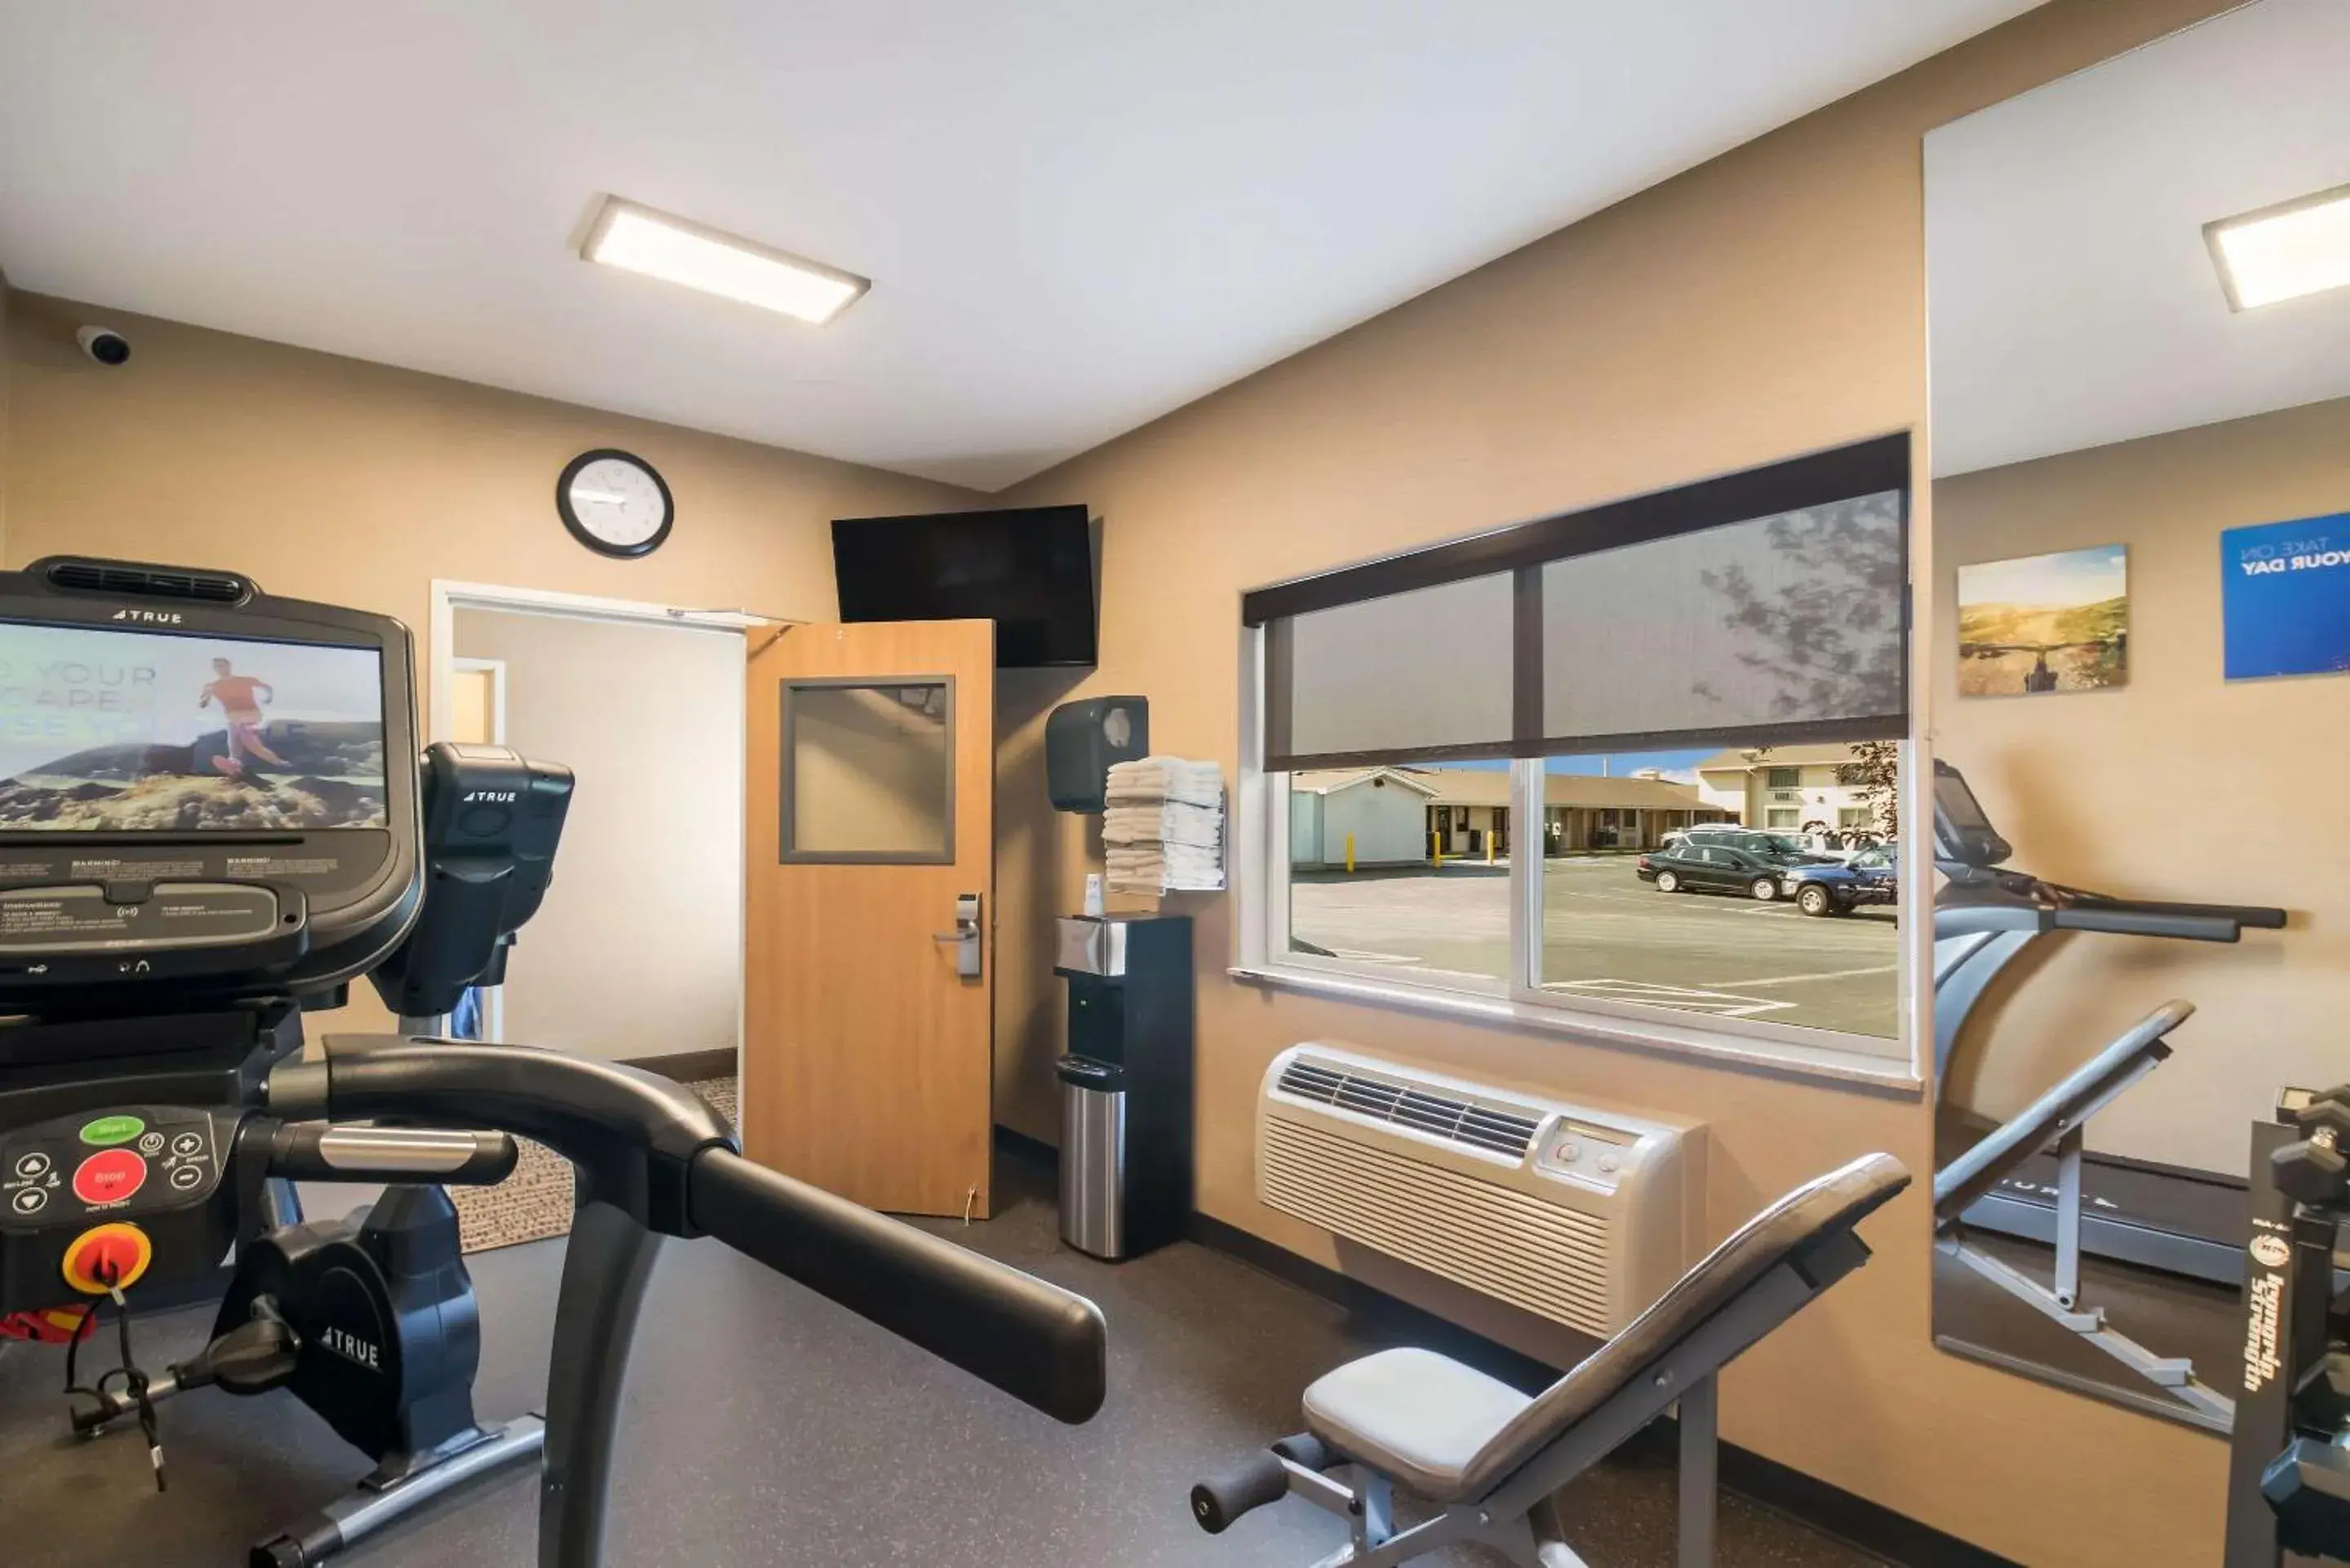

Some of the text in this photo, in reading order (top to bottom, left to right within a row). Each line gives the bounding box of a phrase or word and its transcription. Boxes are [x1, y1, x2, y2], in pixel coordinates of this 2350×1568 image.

[129, 609, 182, 624] TRUE
[38, 662, 157, 687] YOUR
[477, 791, 517, 802] TRUE
[334, 1327, 379, 1368] TRUE
